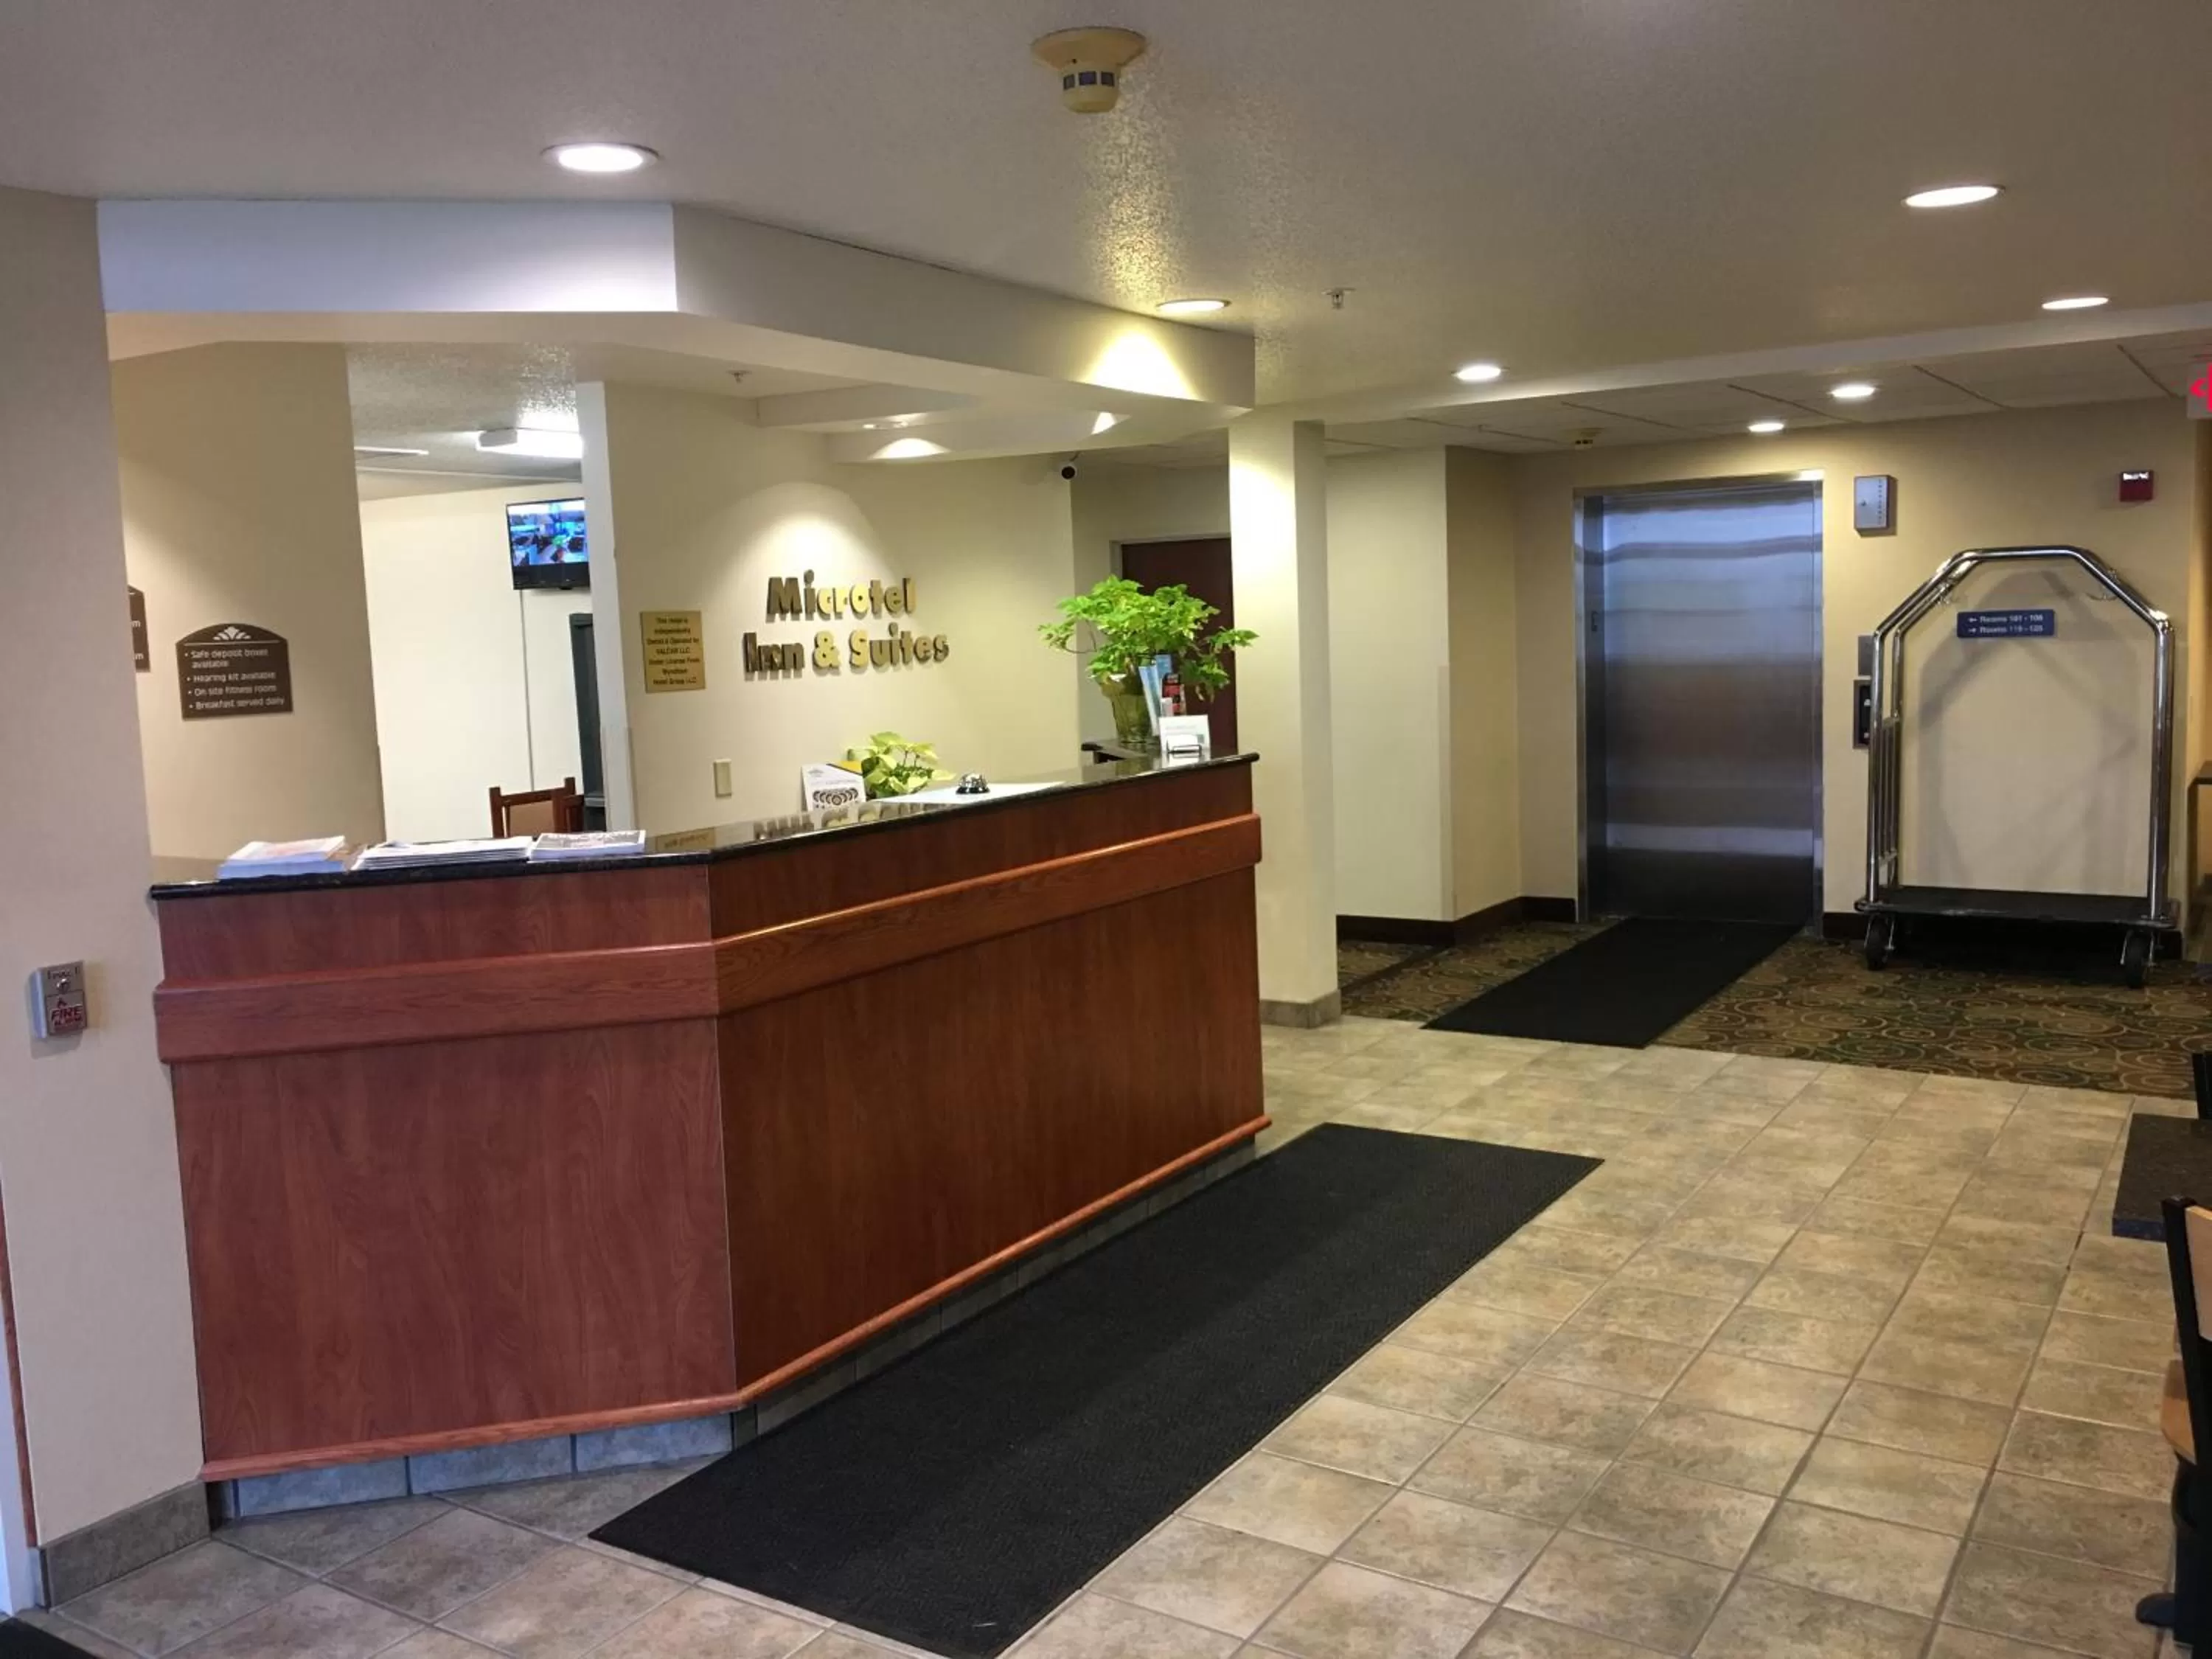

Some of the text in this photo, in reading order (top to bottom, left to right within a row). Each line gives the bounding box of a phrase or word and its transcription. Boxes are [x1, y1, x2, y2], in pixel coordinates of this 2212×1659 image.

[766, 569, 917, 615] Microtel
[742, 622, 950, 672] Inn & Suites
[191, 650, 210, 658] Safe
[211, 649, 243, 659] deposit
[193, 674, 226, 684] Hearing
[194, 687, 207, 697] On
[254, 684, 277, 693] room
[195, 699, 234, 709] Breakfast
[265, 695, 285, 706] daily
